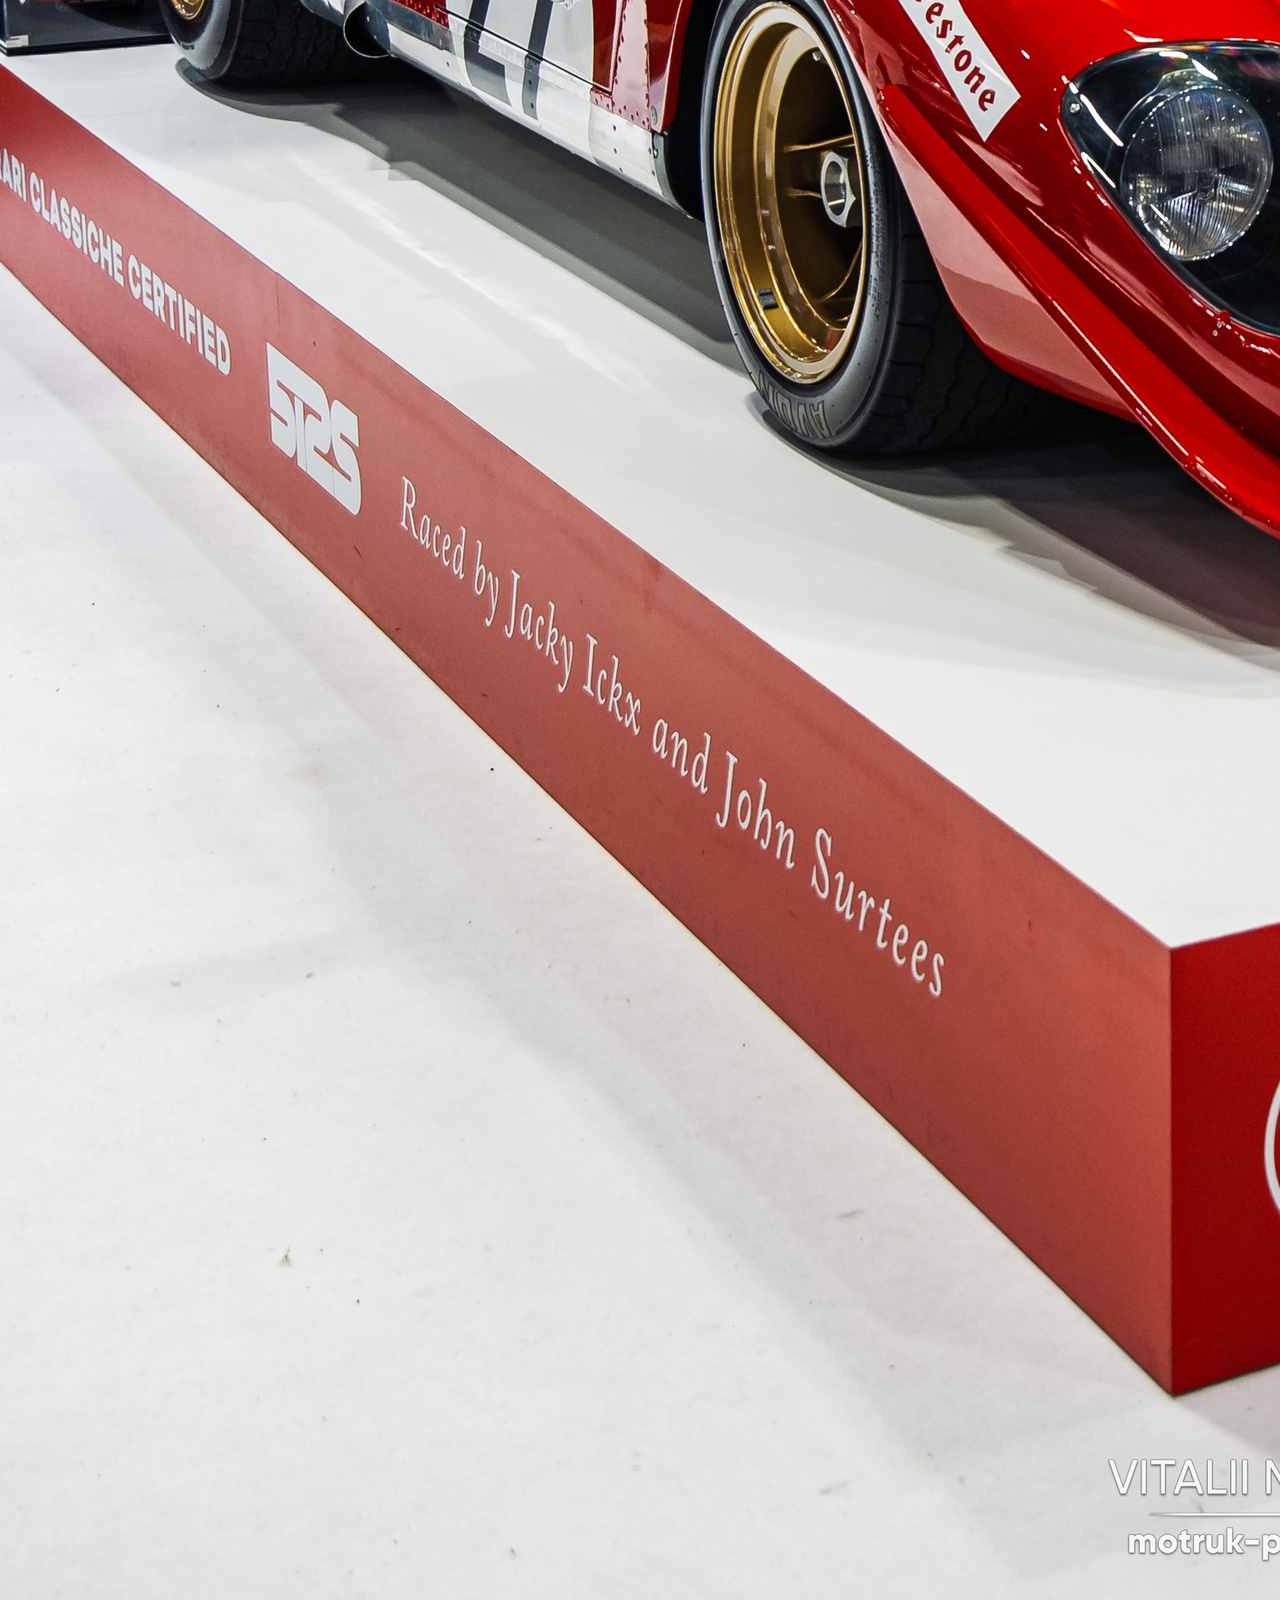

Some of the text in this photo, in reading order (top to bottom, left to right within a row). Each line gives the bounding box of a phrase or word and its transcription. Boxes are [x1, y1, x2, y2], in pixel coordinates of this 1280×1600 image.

[30, 171, 125, 287] CLASSICHE
[128, 254, 231, 376] CERTIFIED
[266, 341, 362, 516] 512S
[400, 474, 945, 998] Raced by Jacky Ickx and John Surtees
